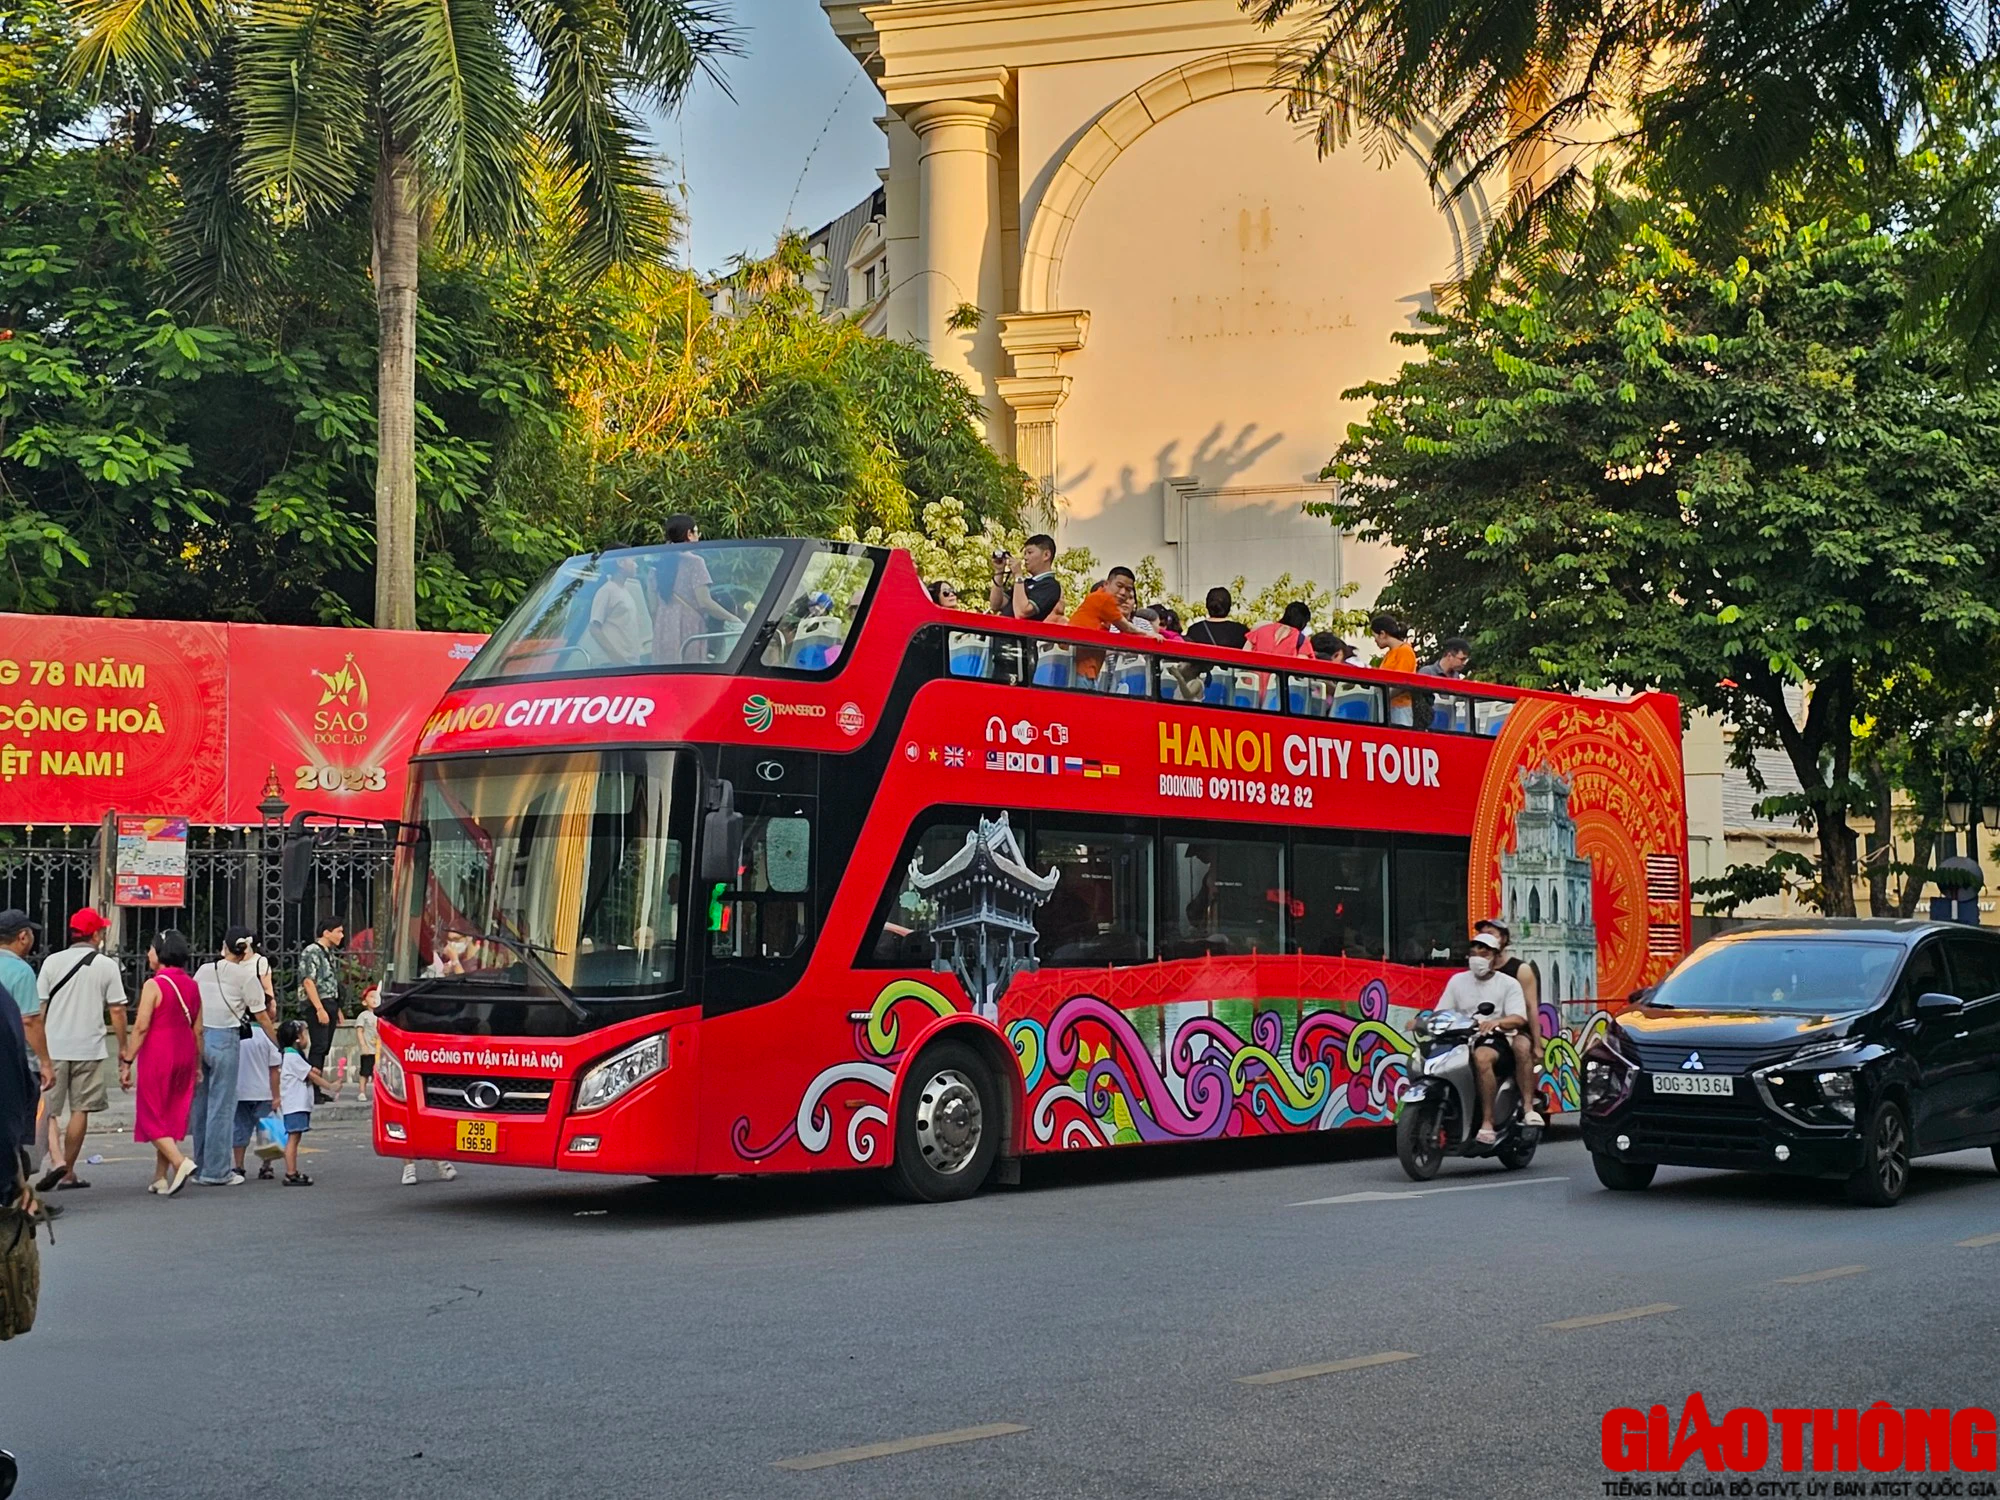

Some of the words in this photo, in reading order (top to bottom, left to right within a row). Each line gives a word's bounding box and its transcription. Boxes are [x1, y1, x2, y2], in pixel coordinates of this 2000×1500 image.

[30, 660, 66, 686] 78
[74, 657, 145, 689] NĂM
[0, 699, 88, 738] CỘNG
[96, 702, 165, 733] HOÀ
[314, 711, 368, 732] SAO
[419, 702, 505, 740] HANOI
[504, 696, 656, 727] CITYTOUR
[773, 703, 826, 717] TRANSERCO
[40, 750, 124, 776] NAM!
[1158, 721, 1272, 773] HANOI
[1283, 734, 1351, 779] CITY
[1361, 741, 1440, 787] TOUR
[295, 765, 387, 792] 2023
[1159, 774, 1203, 798] BOOKING
[1209, 776, 1266, 804] 091193
[1270, 783, 1290, 806] 82
[1294, 785, 1313, 808] 82
[404, 1042, 429, 1062] TỔNG
[431, 1047, 461, 1065] CÔNG
[463, 1051, 475, 1065] TY
[477, 1049, 499, 1069] VẬN
[502, 1049, 519, 1067] TẢI
[521, 1050, 539, 1068] HÀ
[541, 1051, 563, 1072] NỘI
[1655, 1077, 1730, 1093] 30G-313.64
[468, 1122, 486, 1136] 29B
[462, 1136, 492, 1151] 196.58
